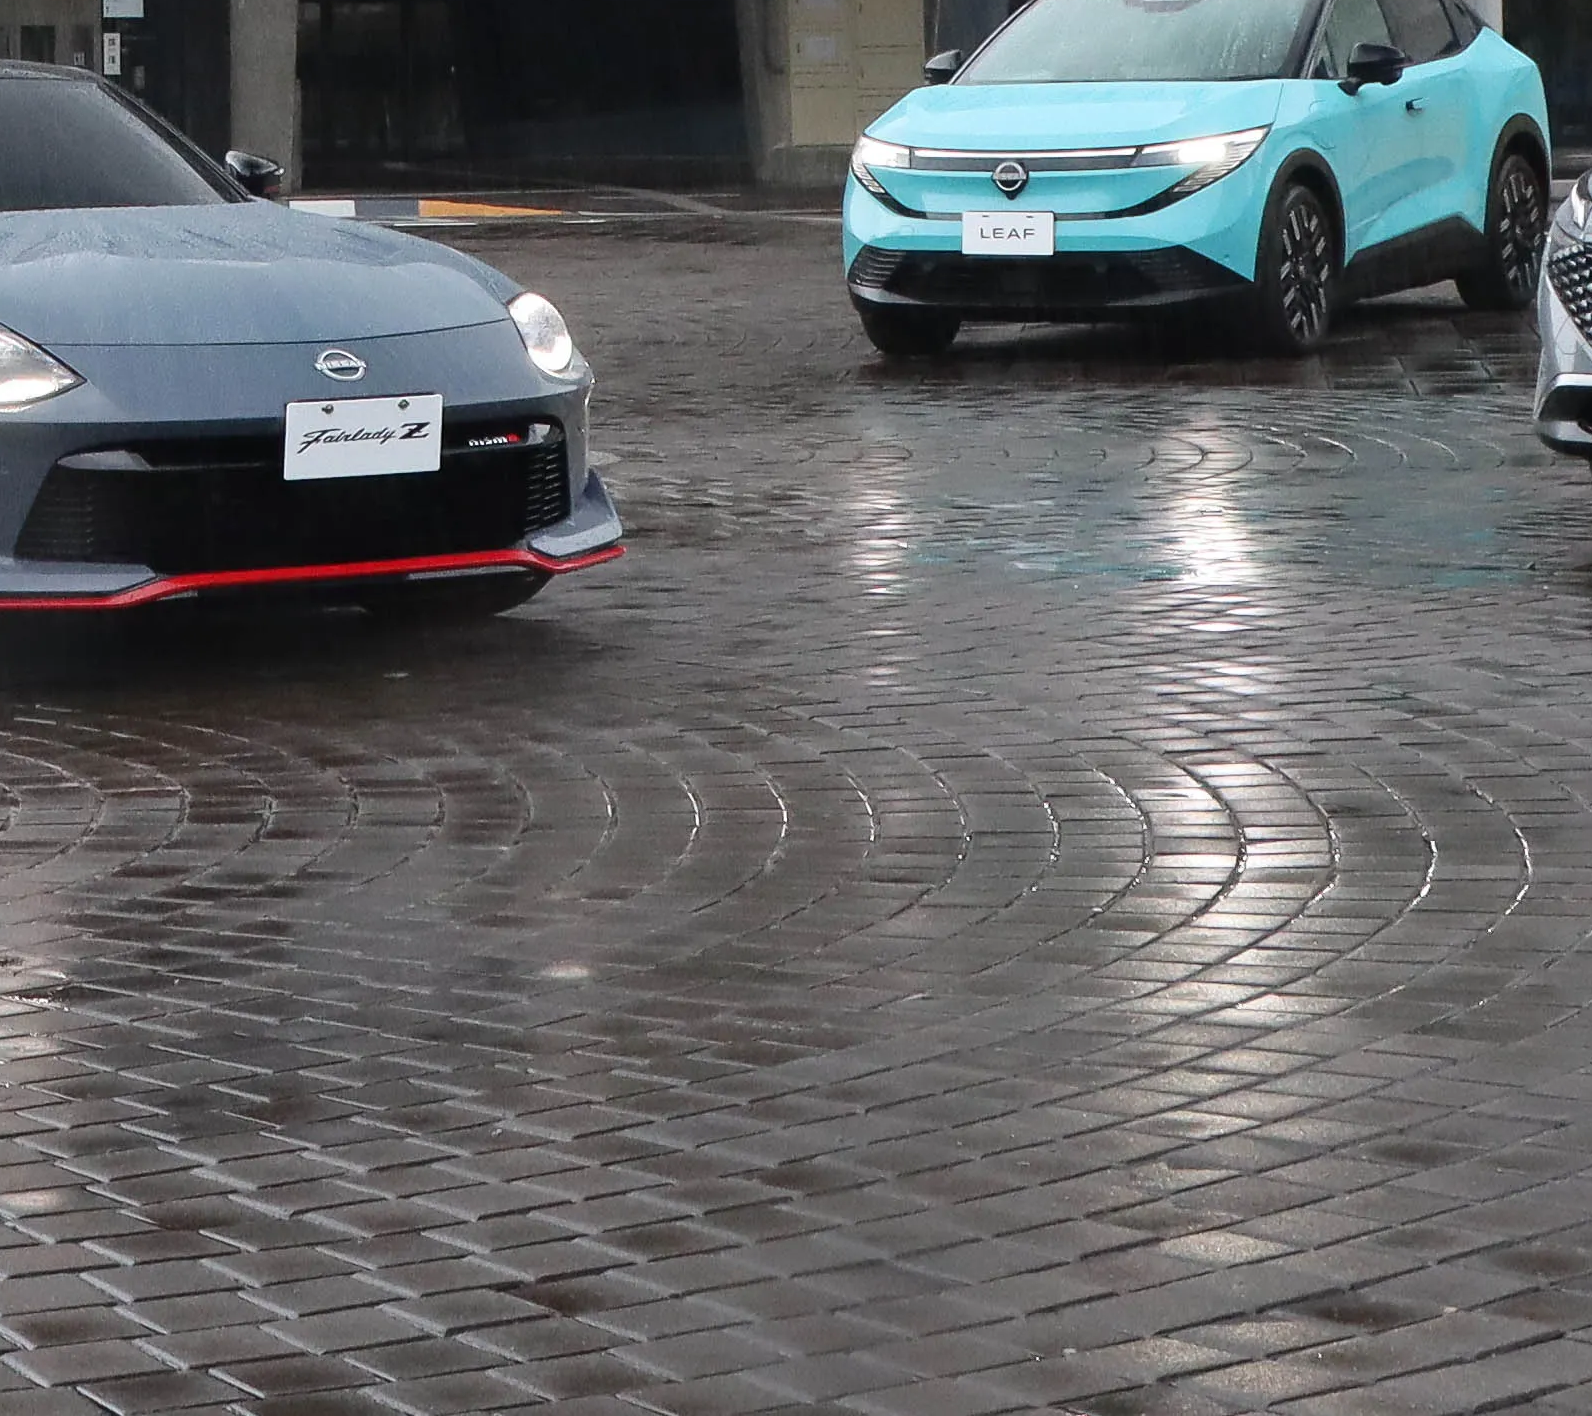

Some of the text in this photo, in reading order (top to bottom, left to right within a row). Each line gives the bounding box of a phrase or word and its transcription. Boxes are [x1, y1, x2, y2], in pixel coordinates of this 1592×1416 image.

[980, 227, 1035, 239] LEAF
[296, 422, 430, 454] Fairlady Z
